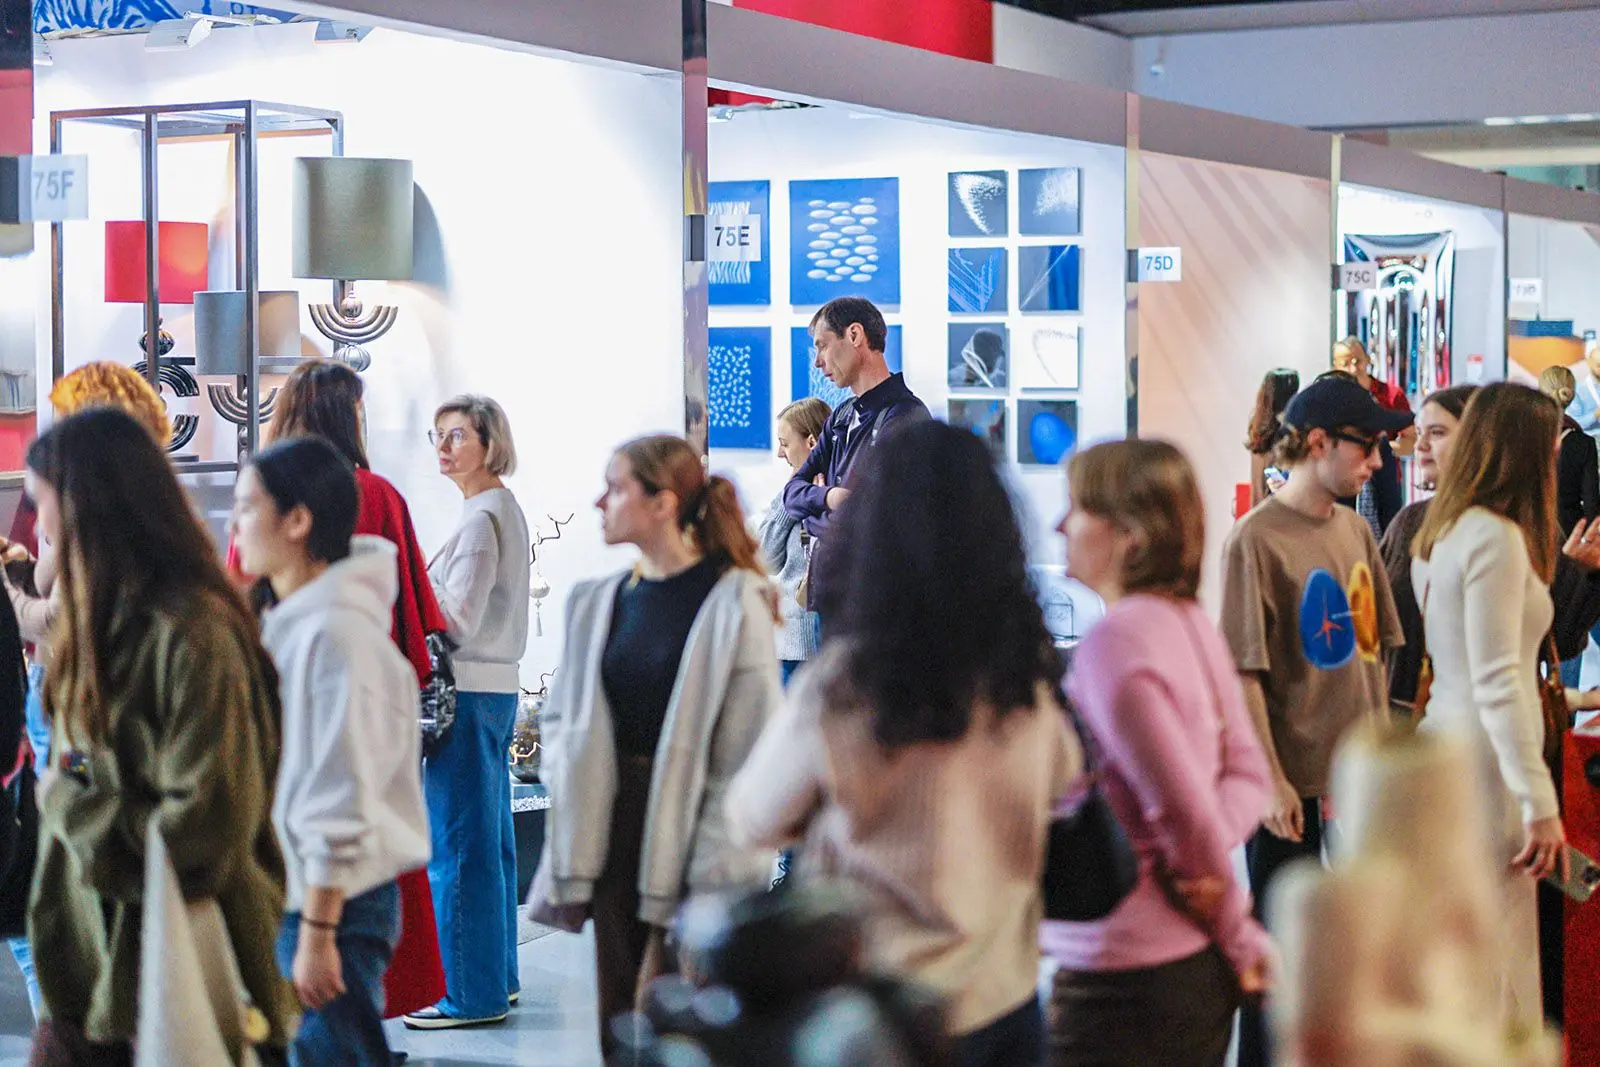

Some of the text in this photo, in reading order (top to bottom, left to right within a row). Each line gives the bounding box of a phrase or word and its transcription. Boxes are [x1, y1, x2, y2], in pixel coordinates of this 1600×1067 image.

[32, 170, 75, 200] 75F
[714, 225, 750, 247] 75E
[1144, 255, 1173, 271] 75D
[1345, 270, 1370, 284] 75C
